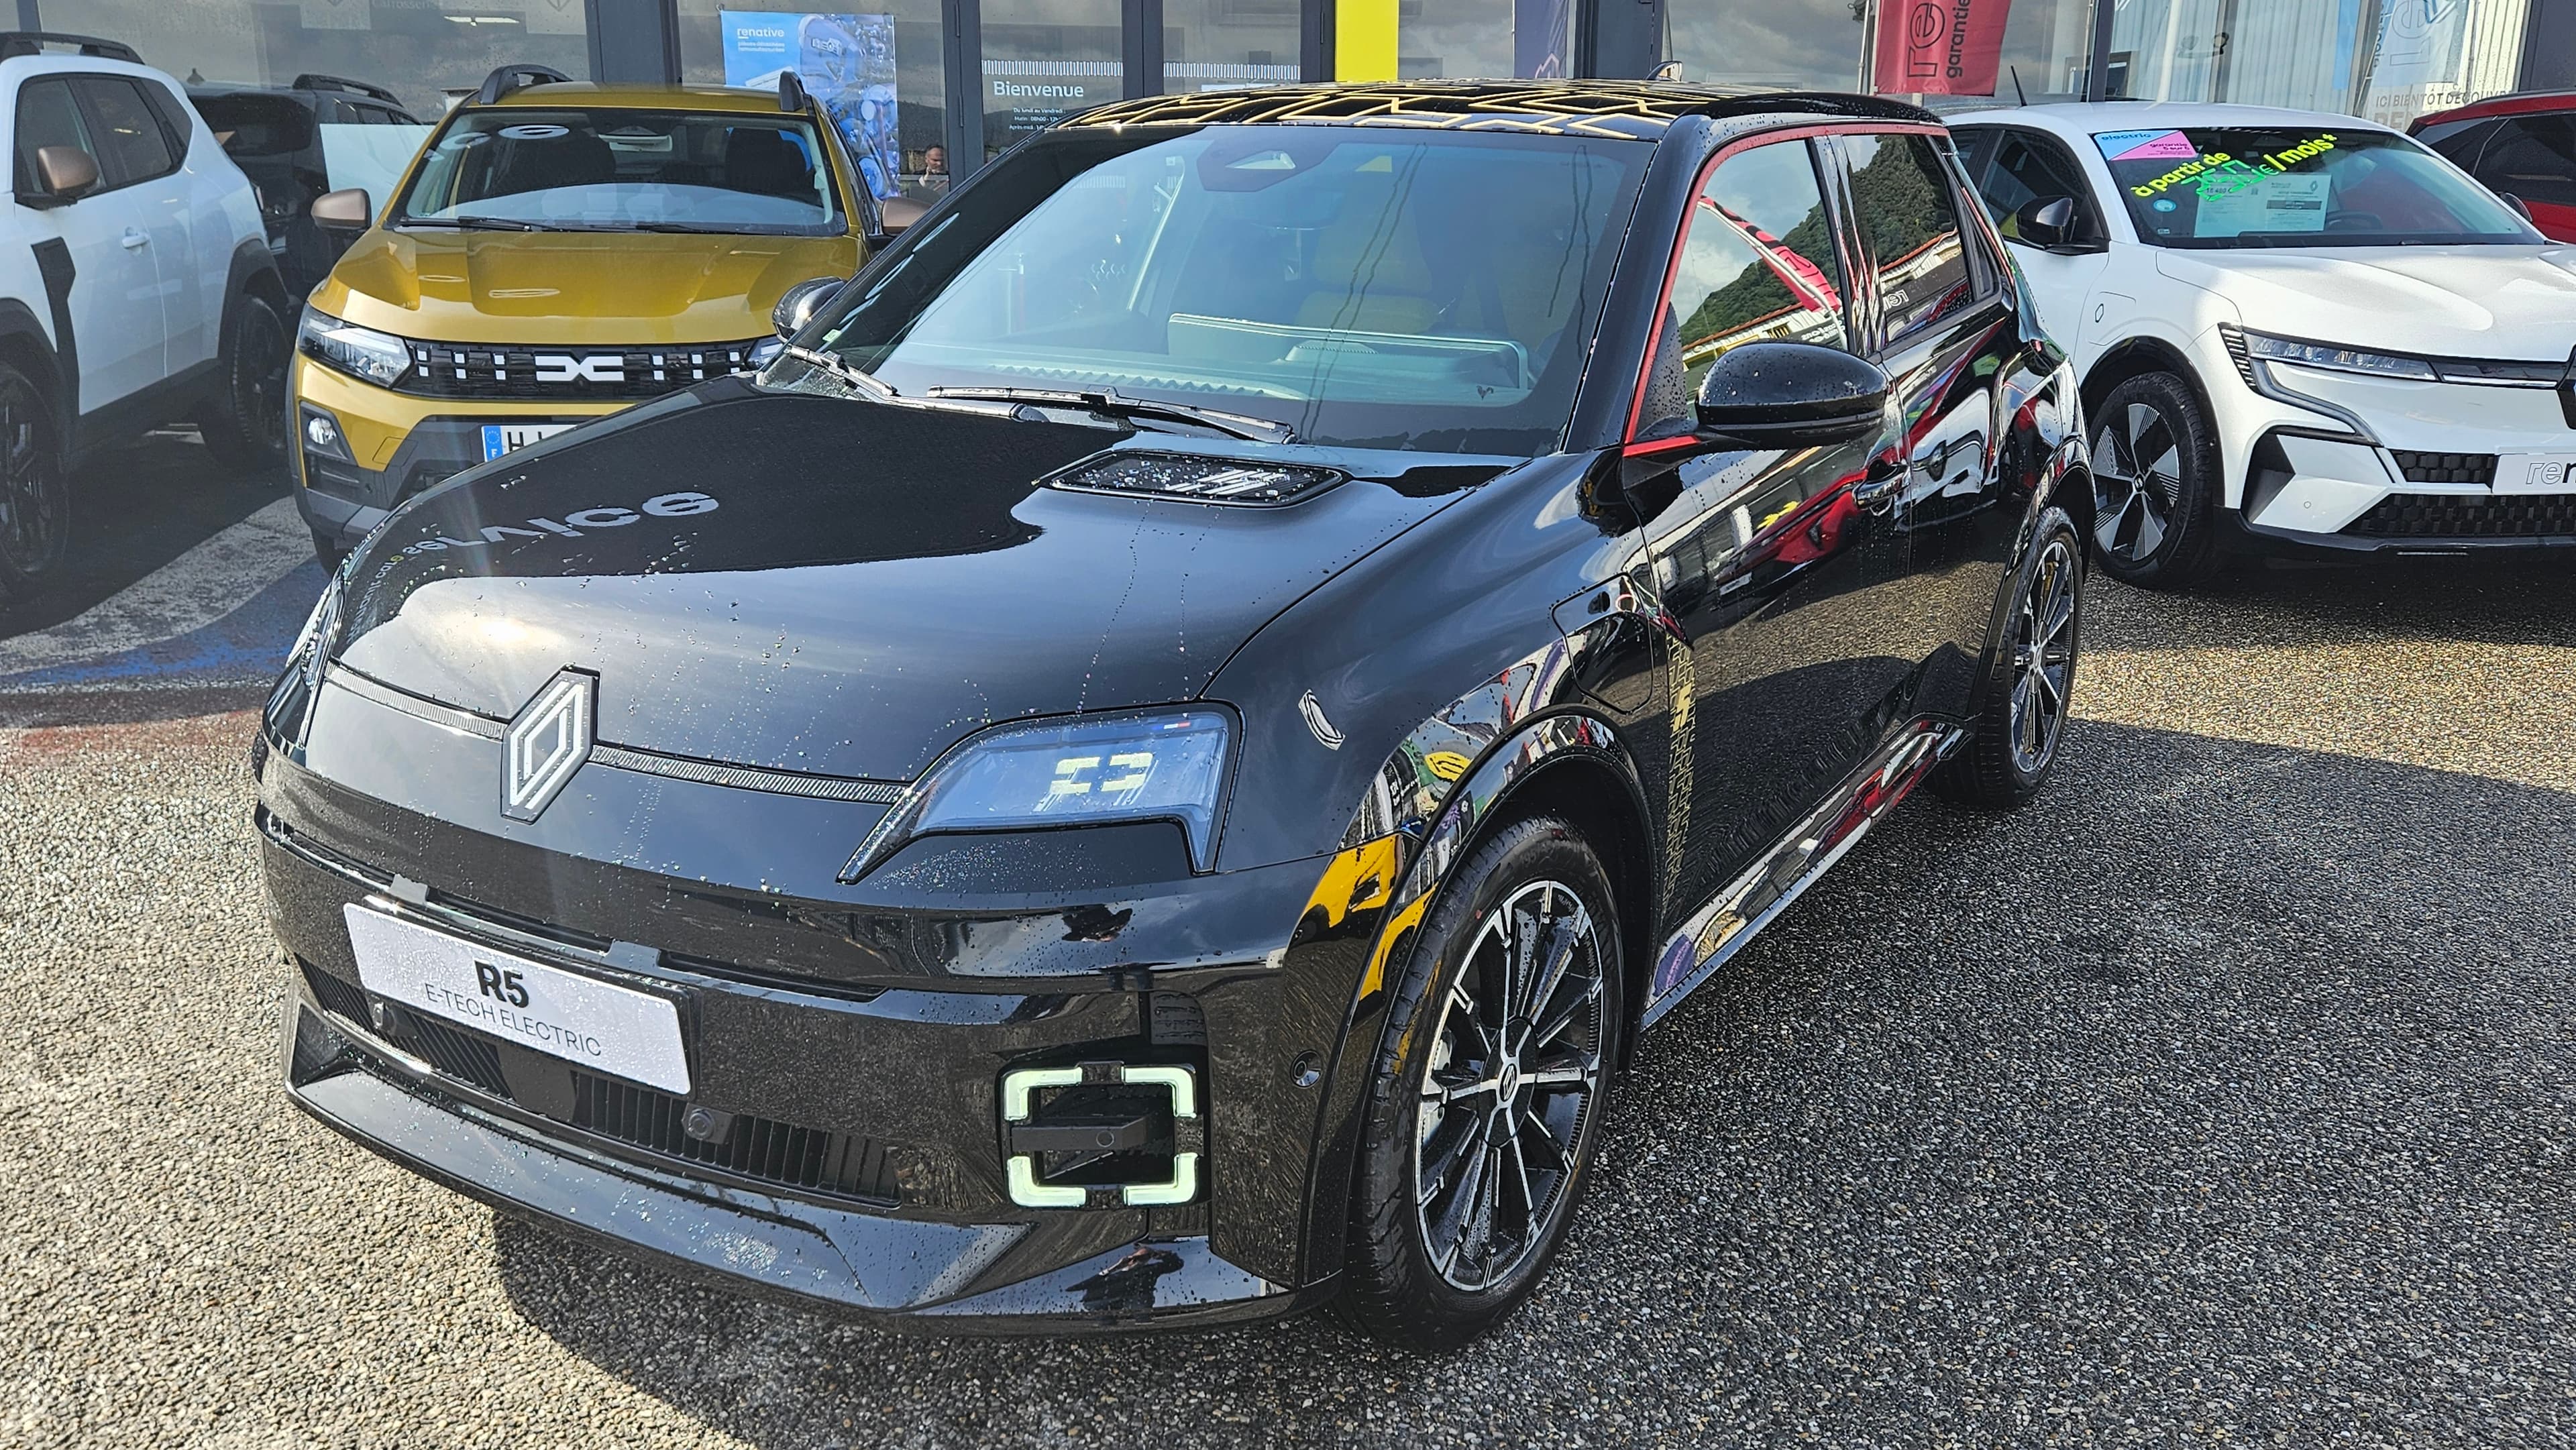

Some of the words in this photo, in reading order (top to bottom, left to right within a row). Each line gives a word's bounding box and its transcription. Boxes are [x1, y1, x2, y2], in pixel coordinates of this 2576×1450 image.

[737, 27, 784, 38] renative
[993, 80, 1084, 97] Bienvenue
[2101, 133, 2151, 141] electric
[2131, 186, 2155, 197] à
[2149, 161, 2206, 192] partir
[2202, 152, 2231, 166] de
[474, 960, 529, 1008] R5
[425, 983, 496, 1023] E-TECH
[500, 1009, 602, 1056] ELECTRIC
